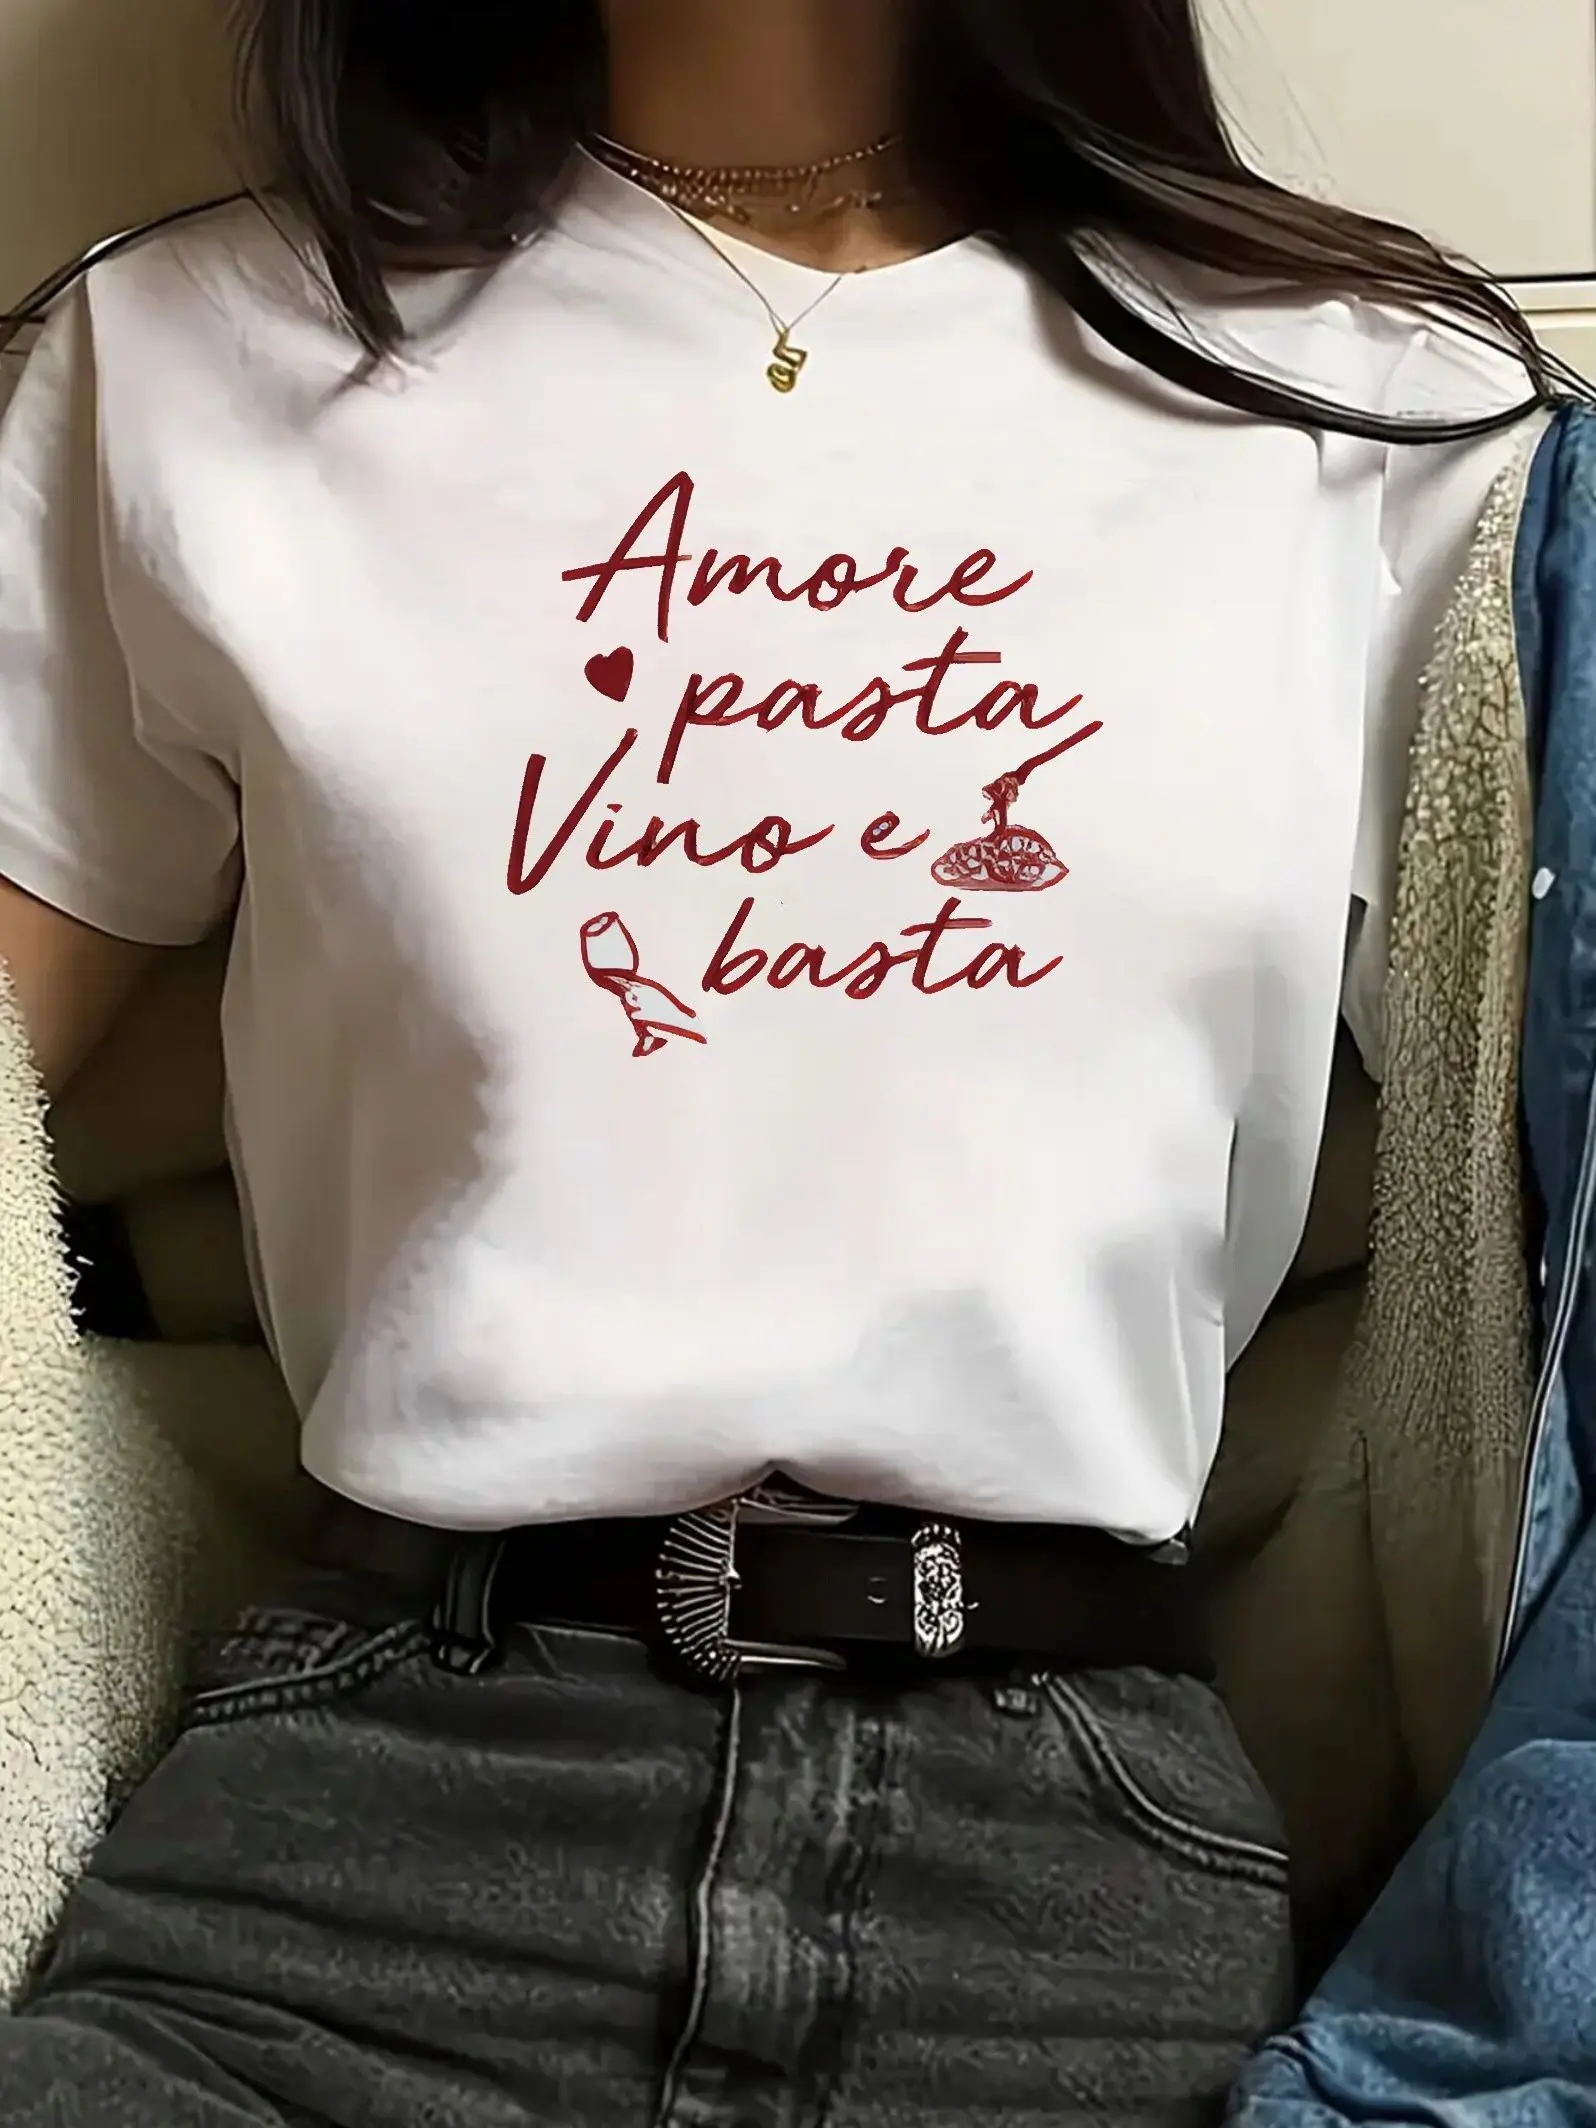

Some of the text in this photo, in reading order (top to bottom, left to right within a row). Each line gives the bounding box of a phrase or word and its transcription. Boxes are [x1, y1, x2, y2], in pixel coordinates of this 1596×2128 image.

[562, 471, 1034, 643] Amore
[656, 627, 1083, 784] pasta
[507, 728, 931, 894] Vino e
[702, 897, 1063, 1000] basta
